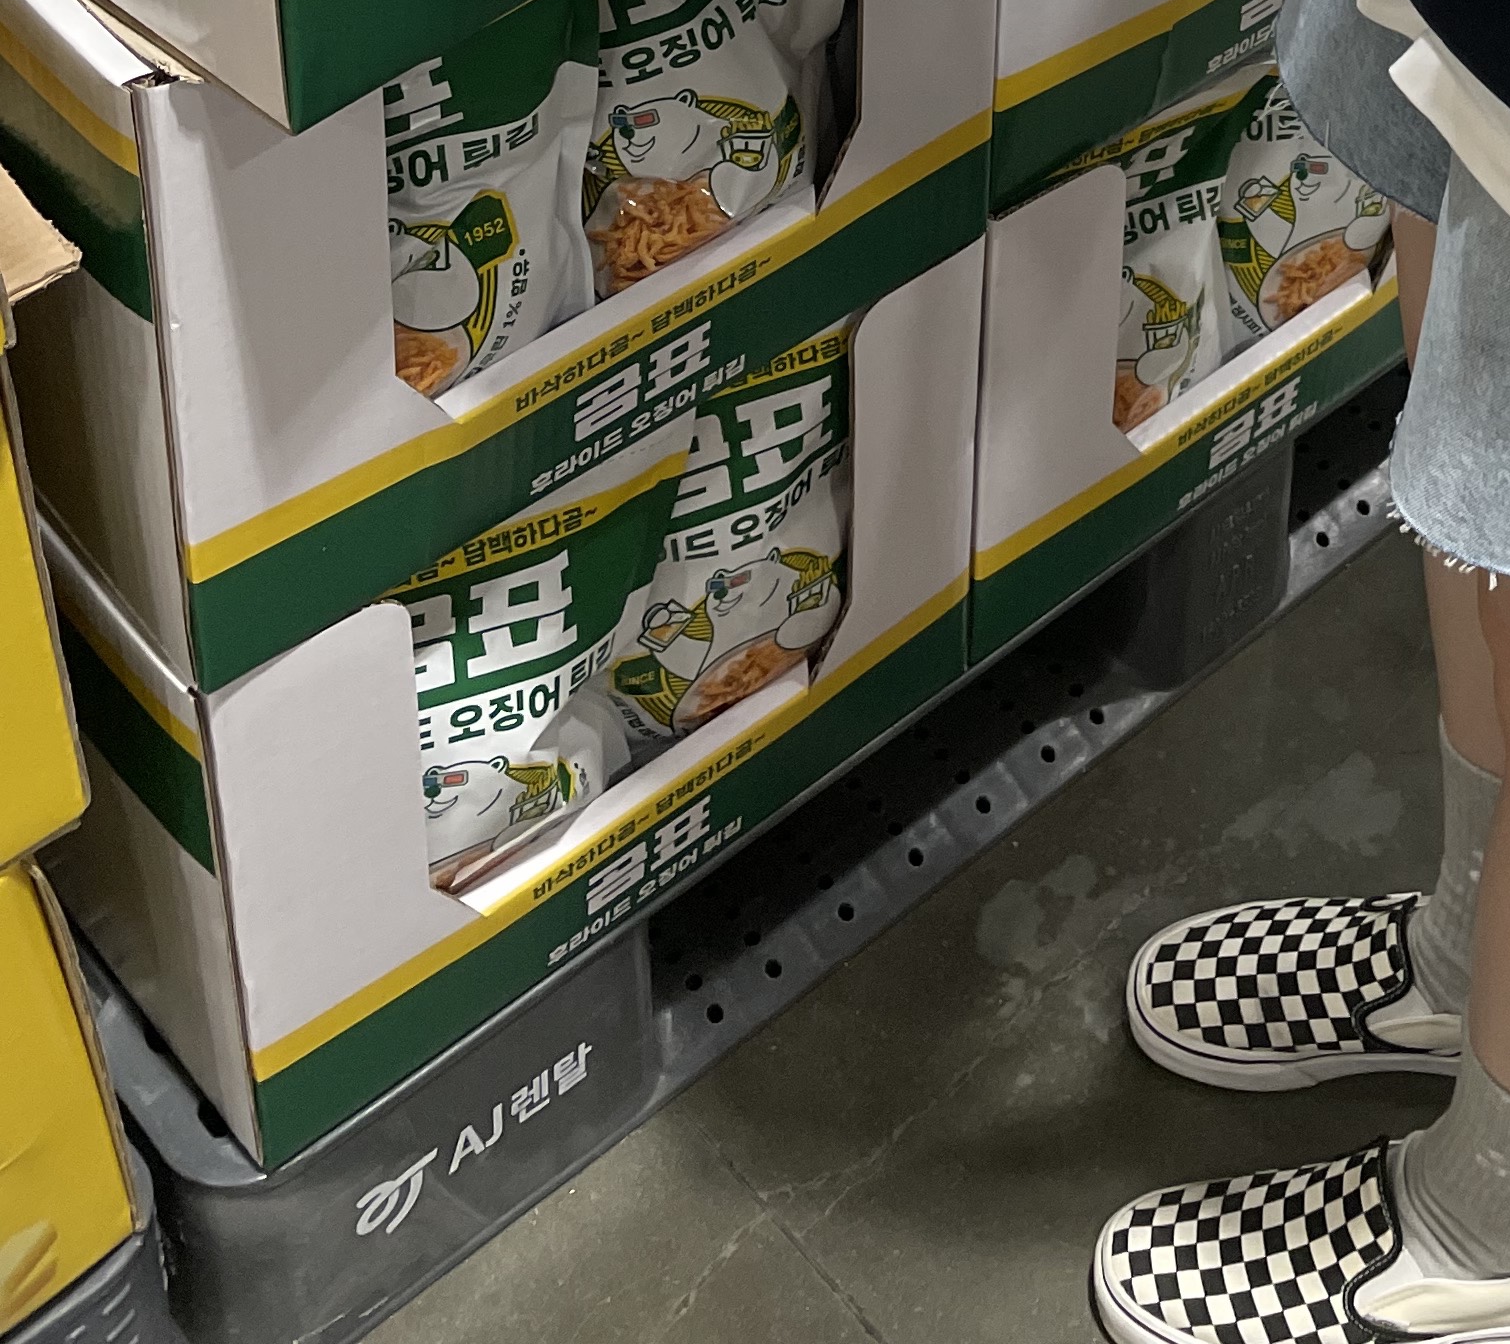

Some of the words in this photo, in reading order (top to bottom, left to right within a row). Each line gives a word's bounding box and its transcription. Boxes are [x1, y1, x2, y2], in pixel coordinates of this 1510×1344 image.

[621, 5, 736, 86] 오징어
[461, 111, 541, 168] 튀김
[463, 216, 507, 247] 1952
[510, 258, 531, 298] 함유
[515, 331, 645, 413] 바삭하다곰~
[650, 253, 774, 333] 담백하다곰~
[529, 428, 624, 496] 후라이드
[628, 386, 697, 438] 오징어
[702, 353, 746, 393] 튀김
[571, 318, 714, 443] 곰표
[1208, 375, 1302, 471] 곰표
[460, 505, 598, 567] 담백하다곰~
[730, 467, 813, 552] 오징어
[447, 674, 562, 745] 오징어
[531, 813, 651, 902] 바삭하다곰~
[655, 732, 767, 816] 담백하다곰~
[585, 795, 712, 916] 곰표
[546, 906, 633, 968] 후라이드
[636, 853, 700, 901] 오징어
